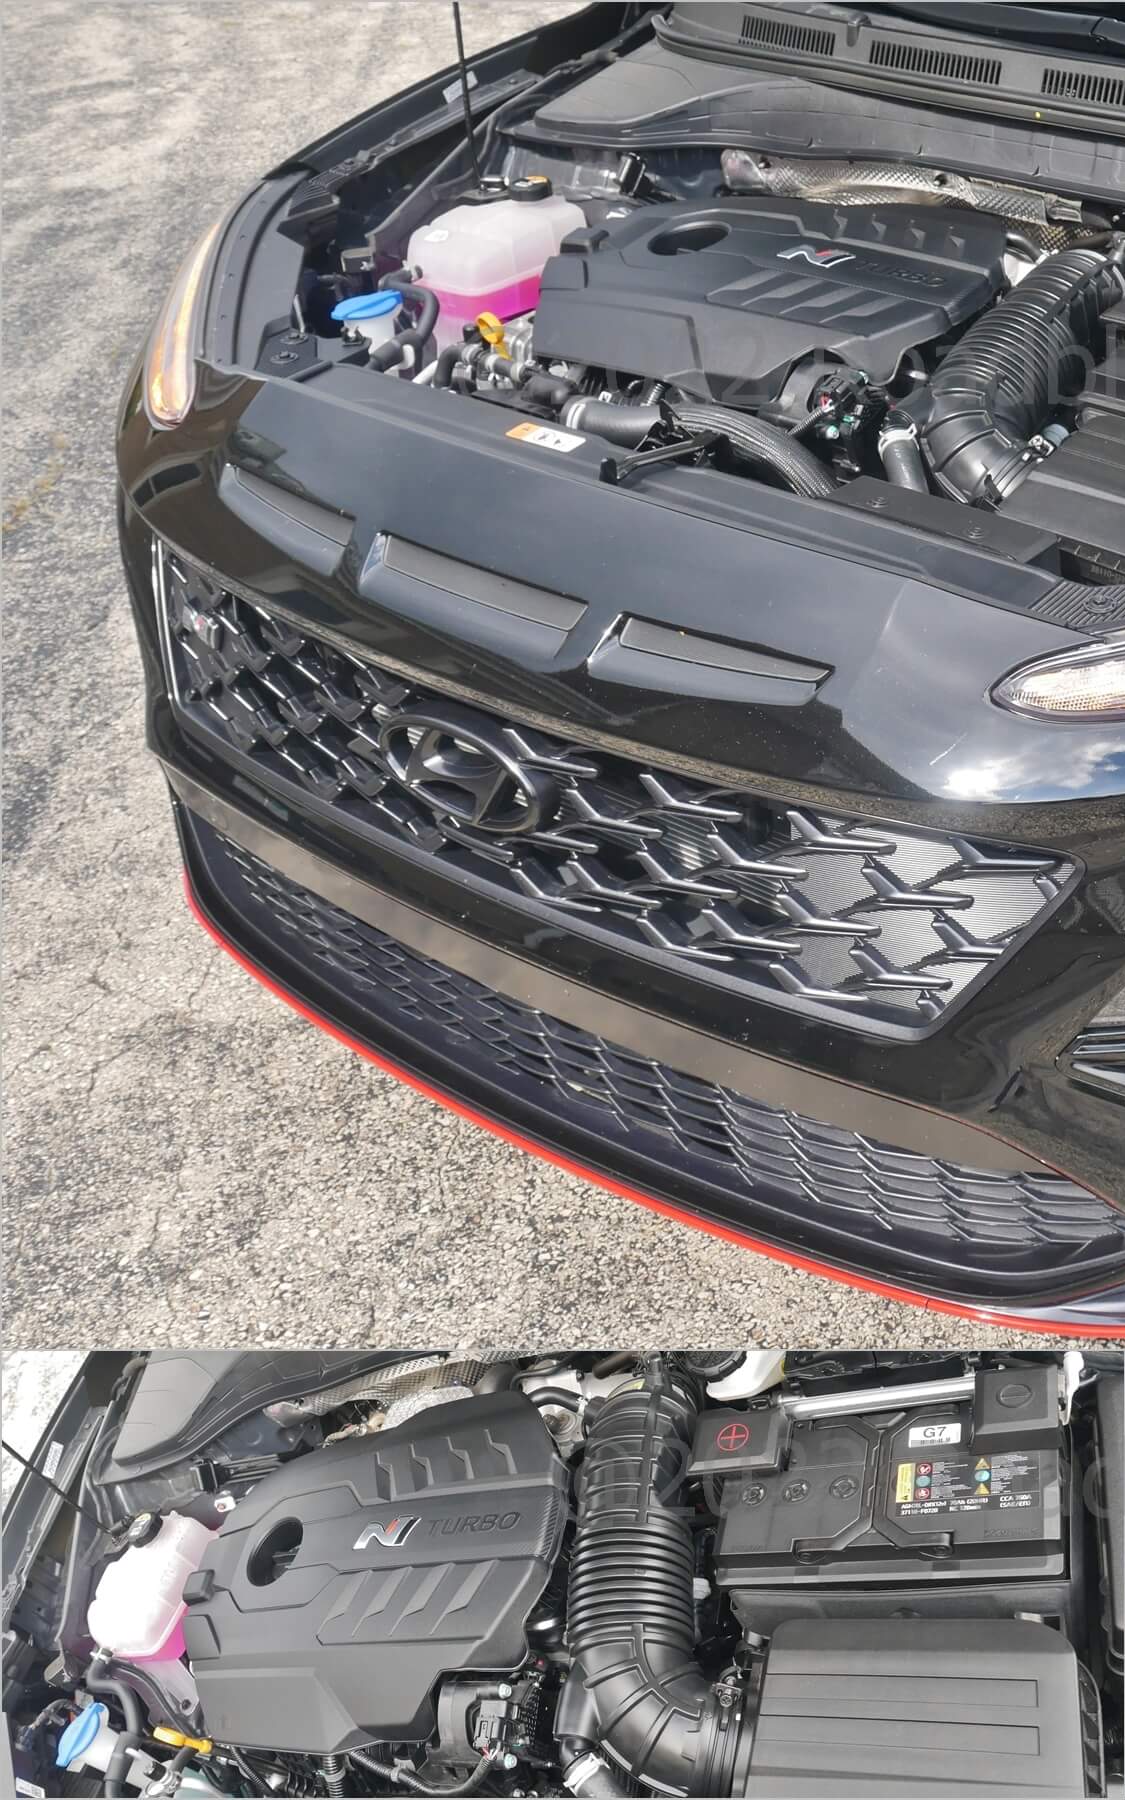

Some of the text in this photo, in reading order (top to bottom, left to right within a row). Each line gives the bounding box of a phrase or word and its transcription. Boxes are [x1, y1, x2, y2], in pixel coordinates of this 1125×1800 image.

[856, 260, 946, 288] TURBO
[923, 1426, 947, 1439] G7
[429, 1511, 522, 1537] TURBO
